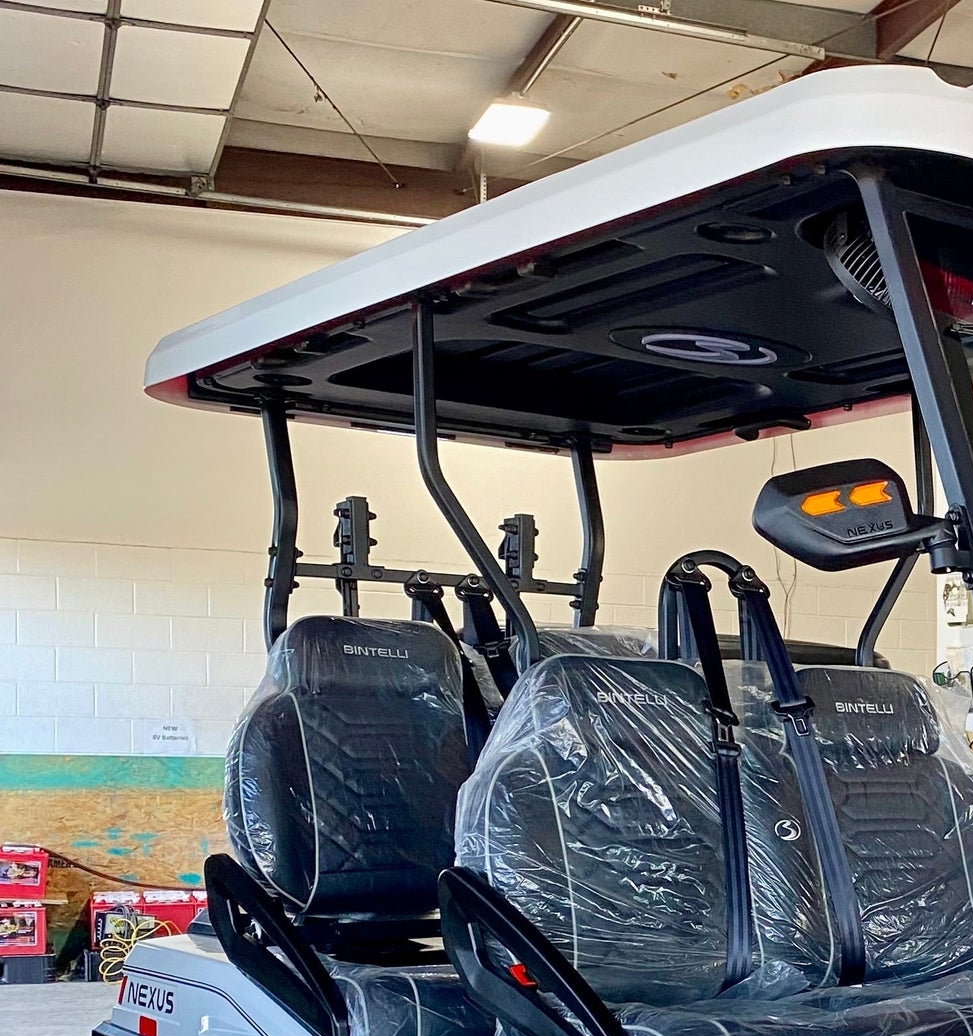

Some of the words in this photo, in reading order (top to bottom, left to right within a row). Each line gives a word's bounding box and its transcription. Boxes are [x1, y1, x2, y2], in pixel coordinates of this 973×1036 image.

[847, 520, 894, 537] NEXUS
[343, 645, 409, 659] BINTELLI
[597, 691, 668, 706] BINTELLI
[836, 702, 894, 715] BINTELLI
[127, 981, 174, 1014] NEXUS
